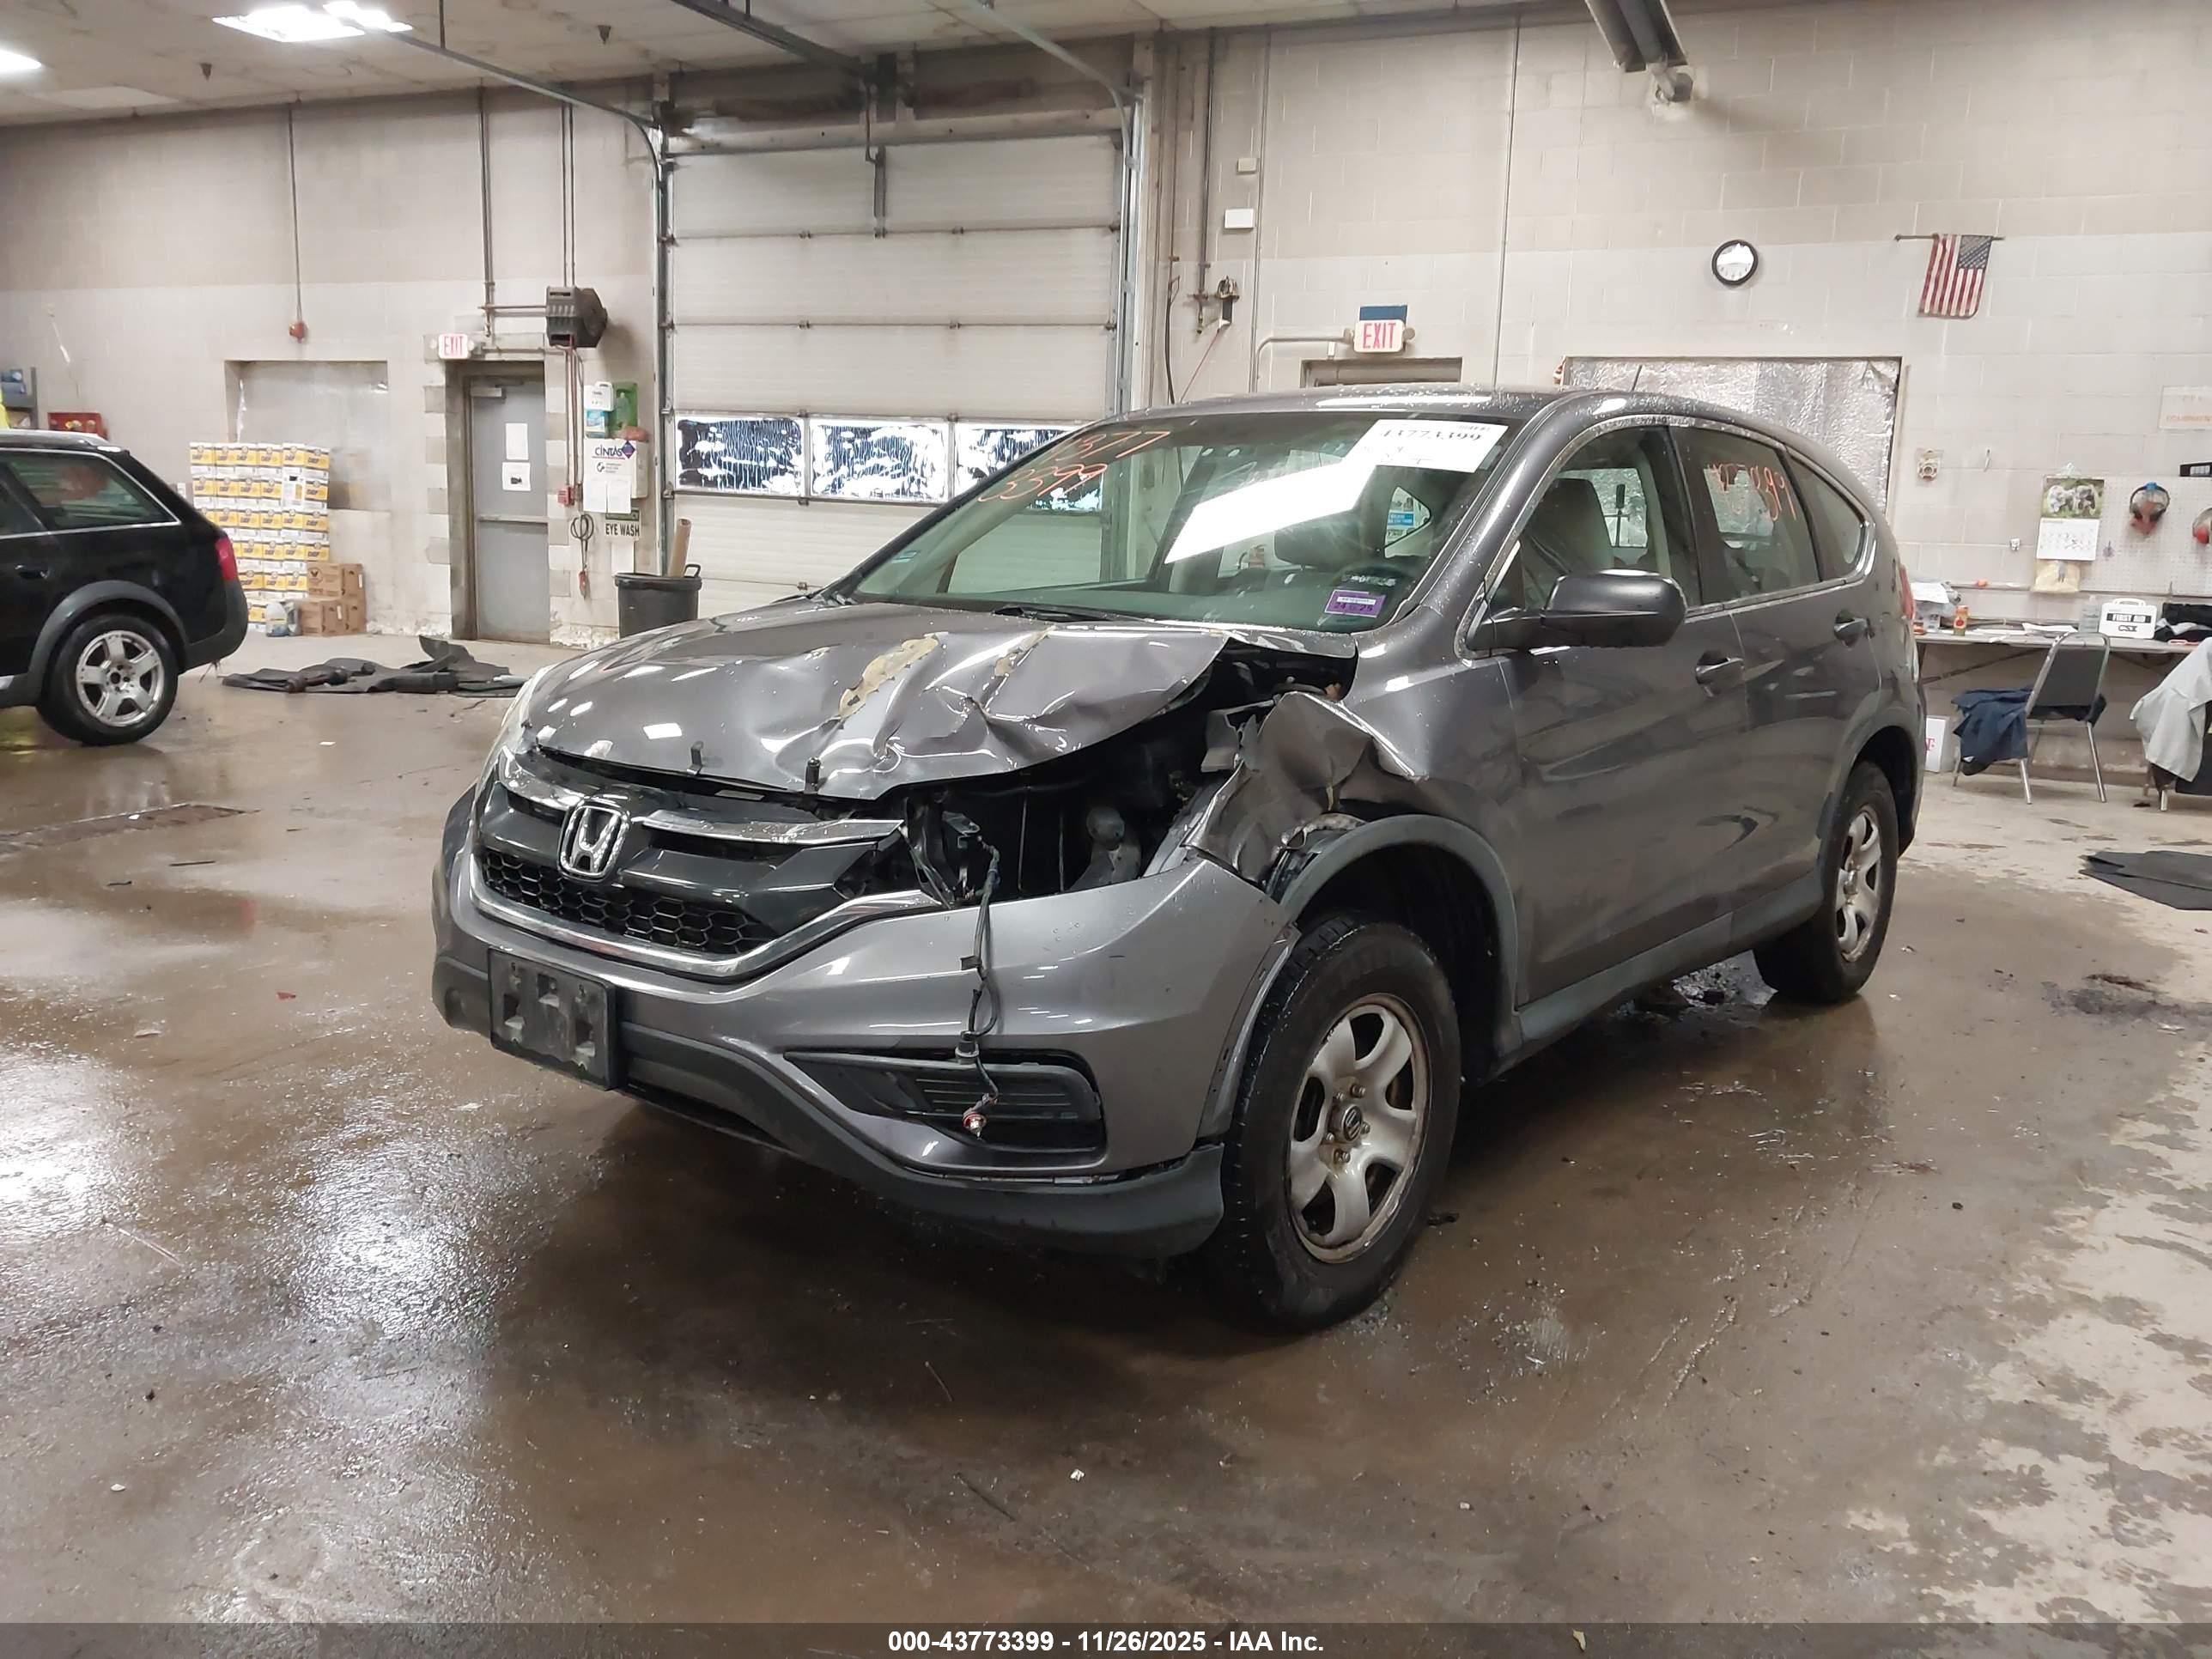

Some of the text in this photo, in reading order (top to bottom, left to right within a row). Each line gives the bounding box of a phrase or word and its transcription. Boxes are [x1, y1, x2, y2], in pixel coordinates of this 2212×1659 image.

[1363, 322, 1396, 349] EXIT
[444, 336, 463, 356] EXIT
[594, 444, 623, 457] CINTAS
[605, 523, 640, 537] EYE WASH
[2112, 613, 2131, 622] FIRST
